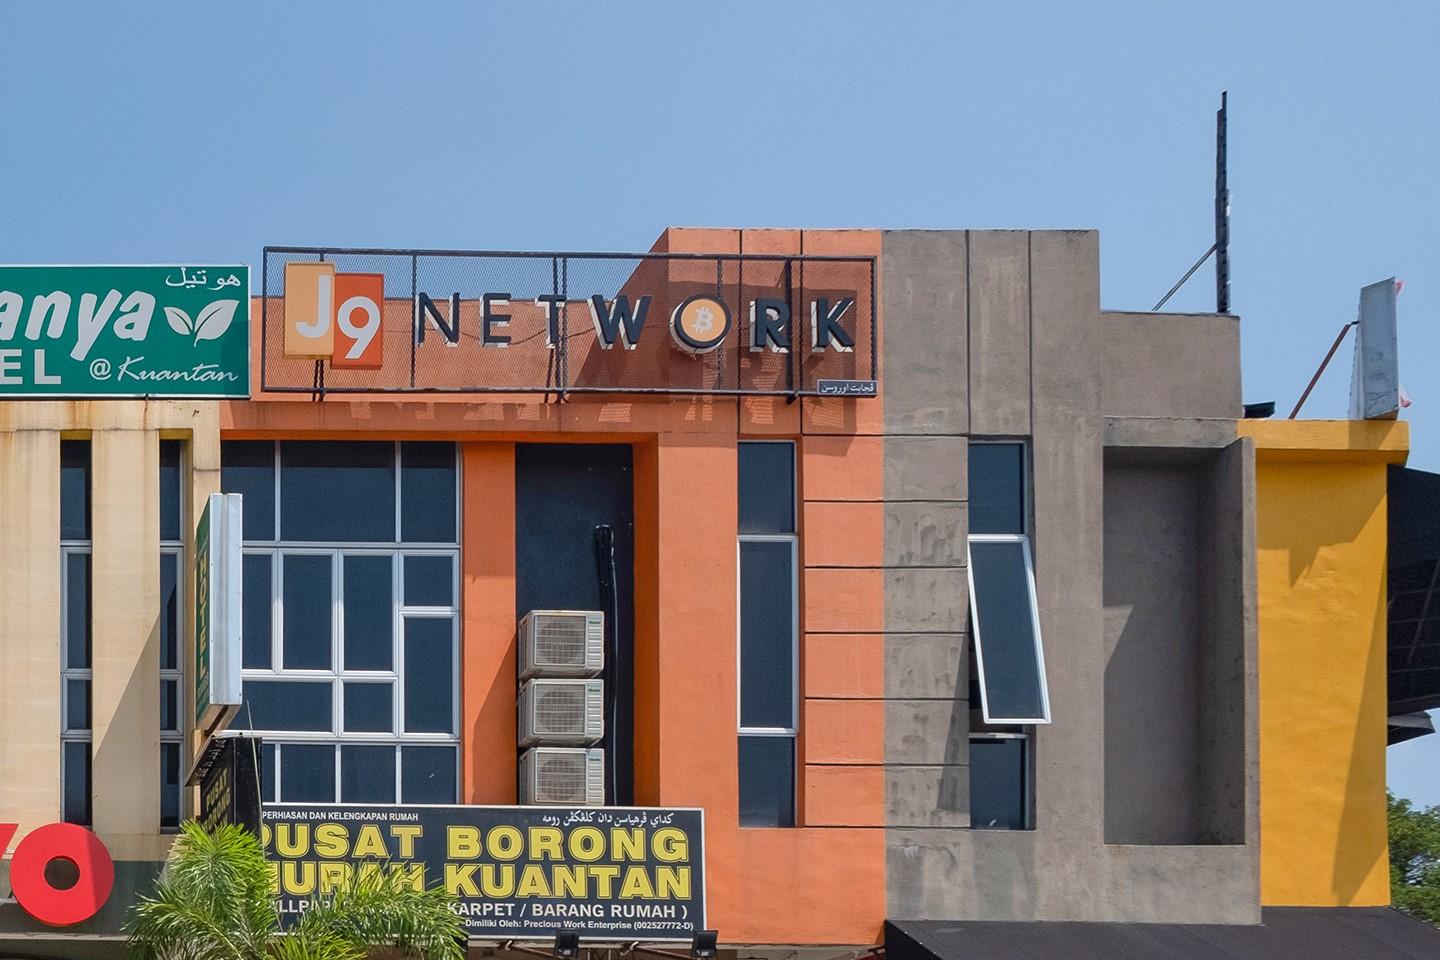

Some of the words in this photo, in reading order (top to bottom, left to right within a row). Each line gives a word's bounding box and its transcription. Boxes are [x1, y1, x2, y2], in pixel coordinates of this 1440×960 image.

[262, 811, 308, 820] PERHIASAN
[309, 811, 327, 820] DAN
[328, 812, 388, 821] KELENGKAPAN
[389, 812, 419, 821] RUMAH
[447, 825, 689, 863] BORONG
[444, 863, 692, 900] KUANTAN
[531, 904, 604, 918] BARANG
[610, 905, 676, 919] RUMAH
[465, 919, 497, 928] Dimiliki
[498, 919, 522, 928] Oleh:
[524, 920, 562, 928] Precious
[563, 920, 586, 929] Work
[587, 921, 632, 931] Enterprise
[633, 921, 694, 931] (002527772-D)
